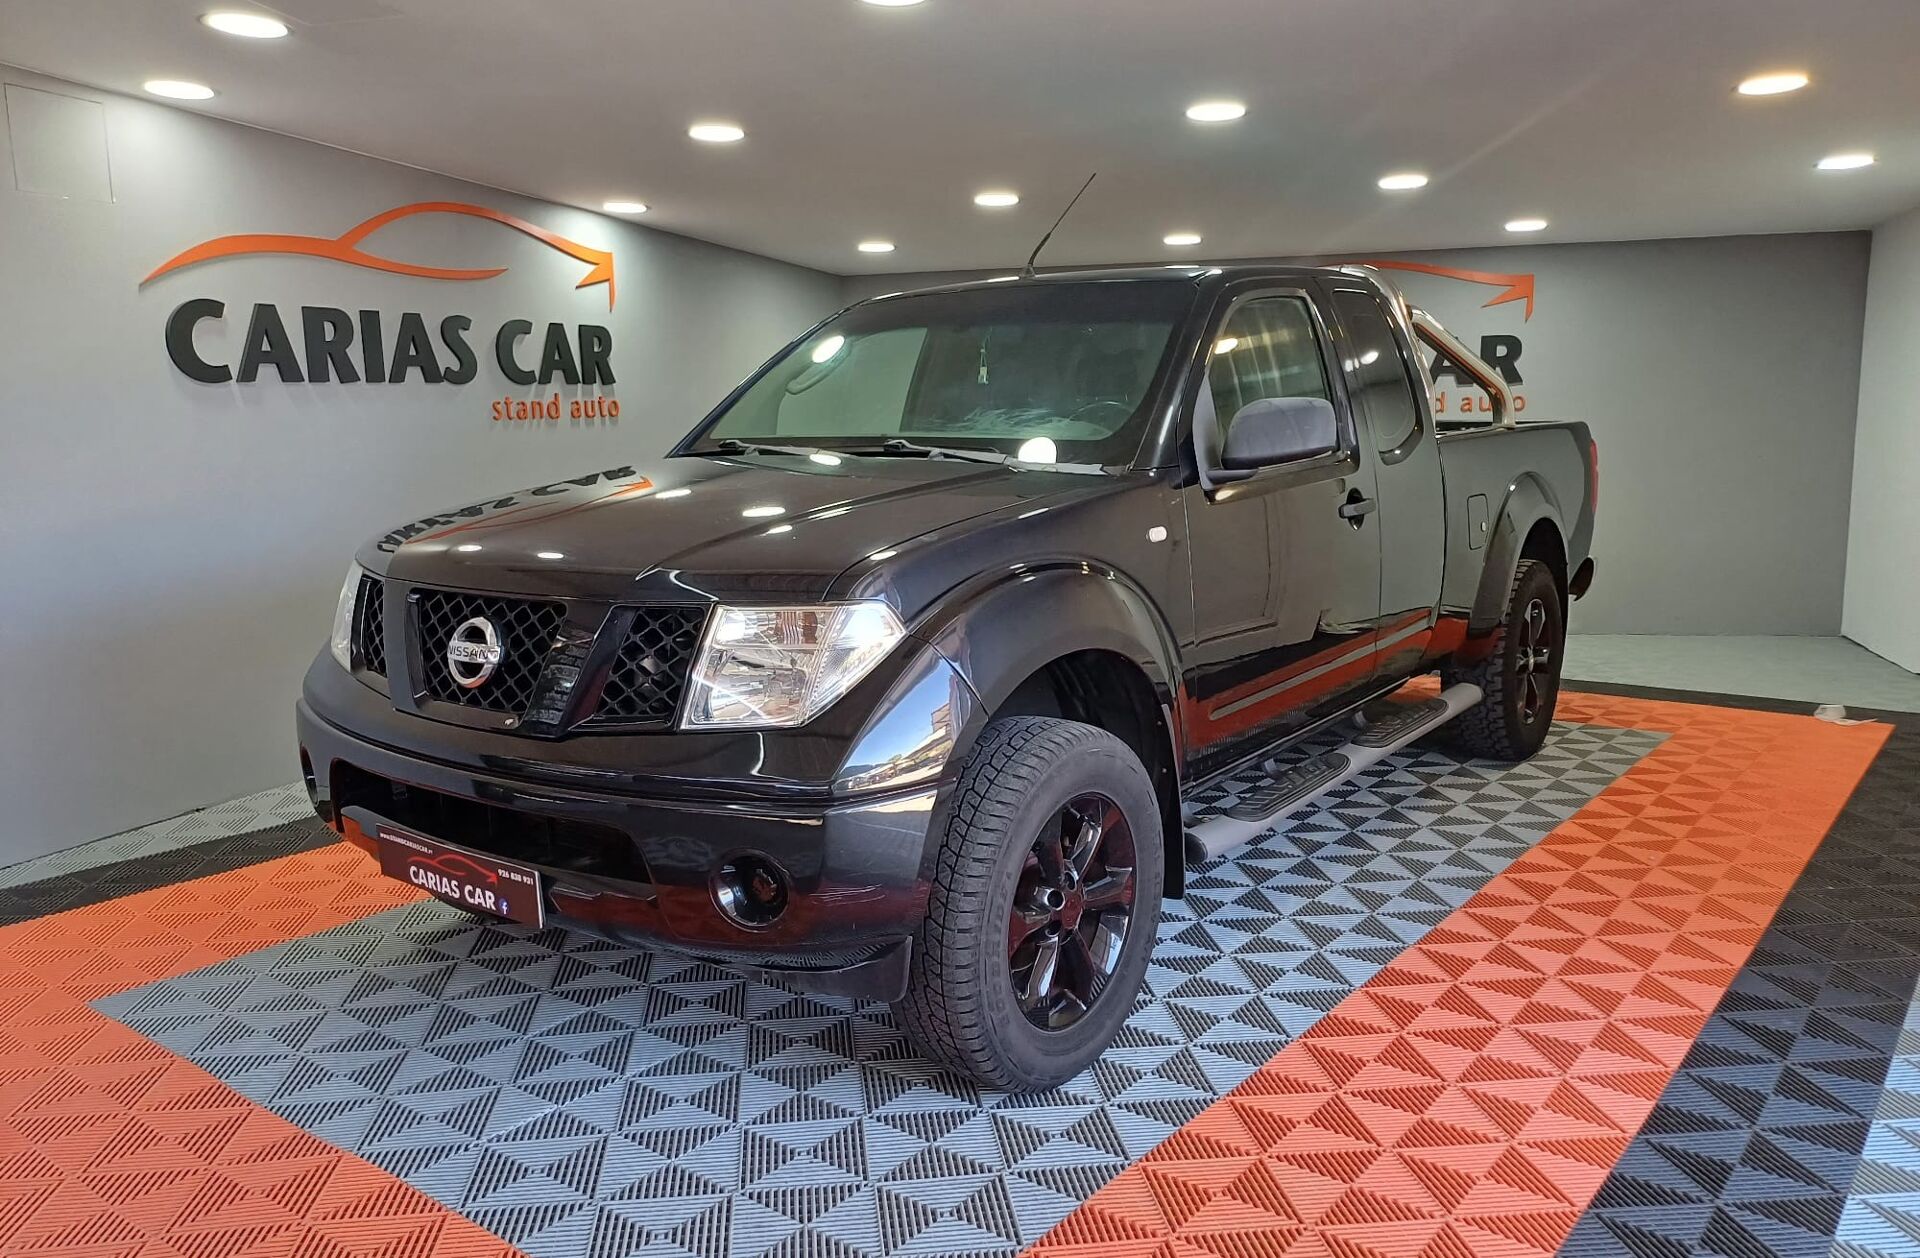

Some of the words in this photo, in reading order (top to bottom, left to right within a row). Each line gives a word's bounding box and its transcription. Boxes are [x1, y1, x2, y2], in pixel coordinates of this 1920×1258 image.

[165, 298, 479, 385] CARIAS
[495, 319, 617, 386] CAR
[1429, 334, 1524, 386] AR
[492, 393, 561, 422] stand
[570, 396, 621, 421] auto
[1460, 394, 1526, 413] auo
[448, 645, 489, 660] NISSAN
[409, 865, 460, 899] CARIAS
[464, 884, 497, 911] CAR
